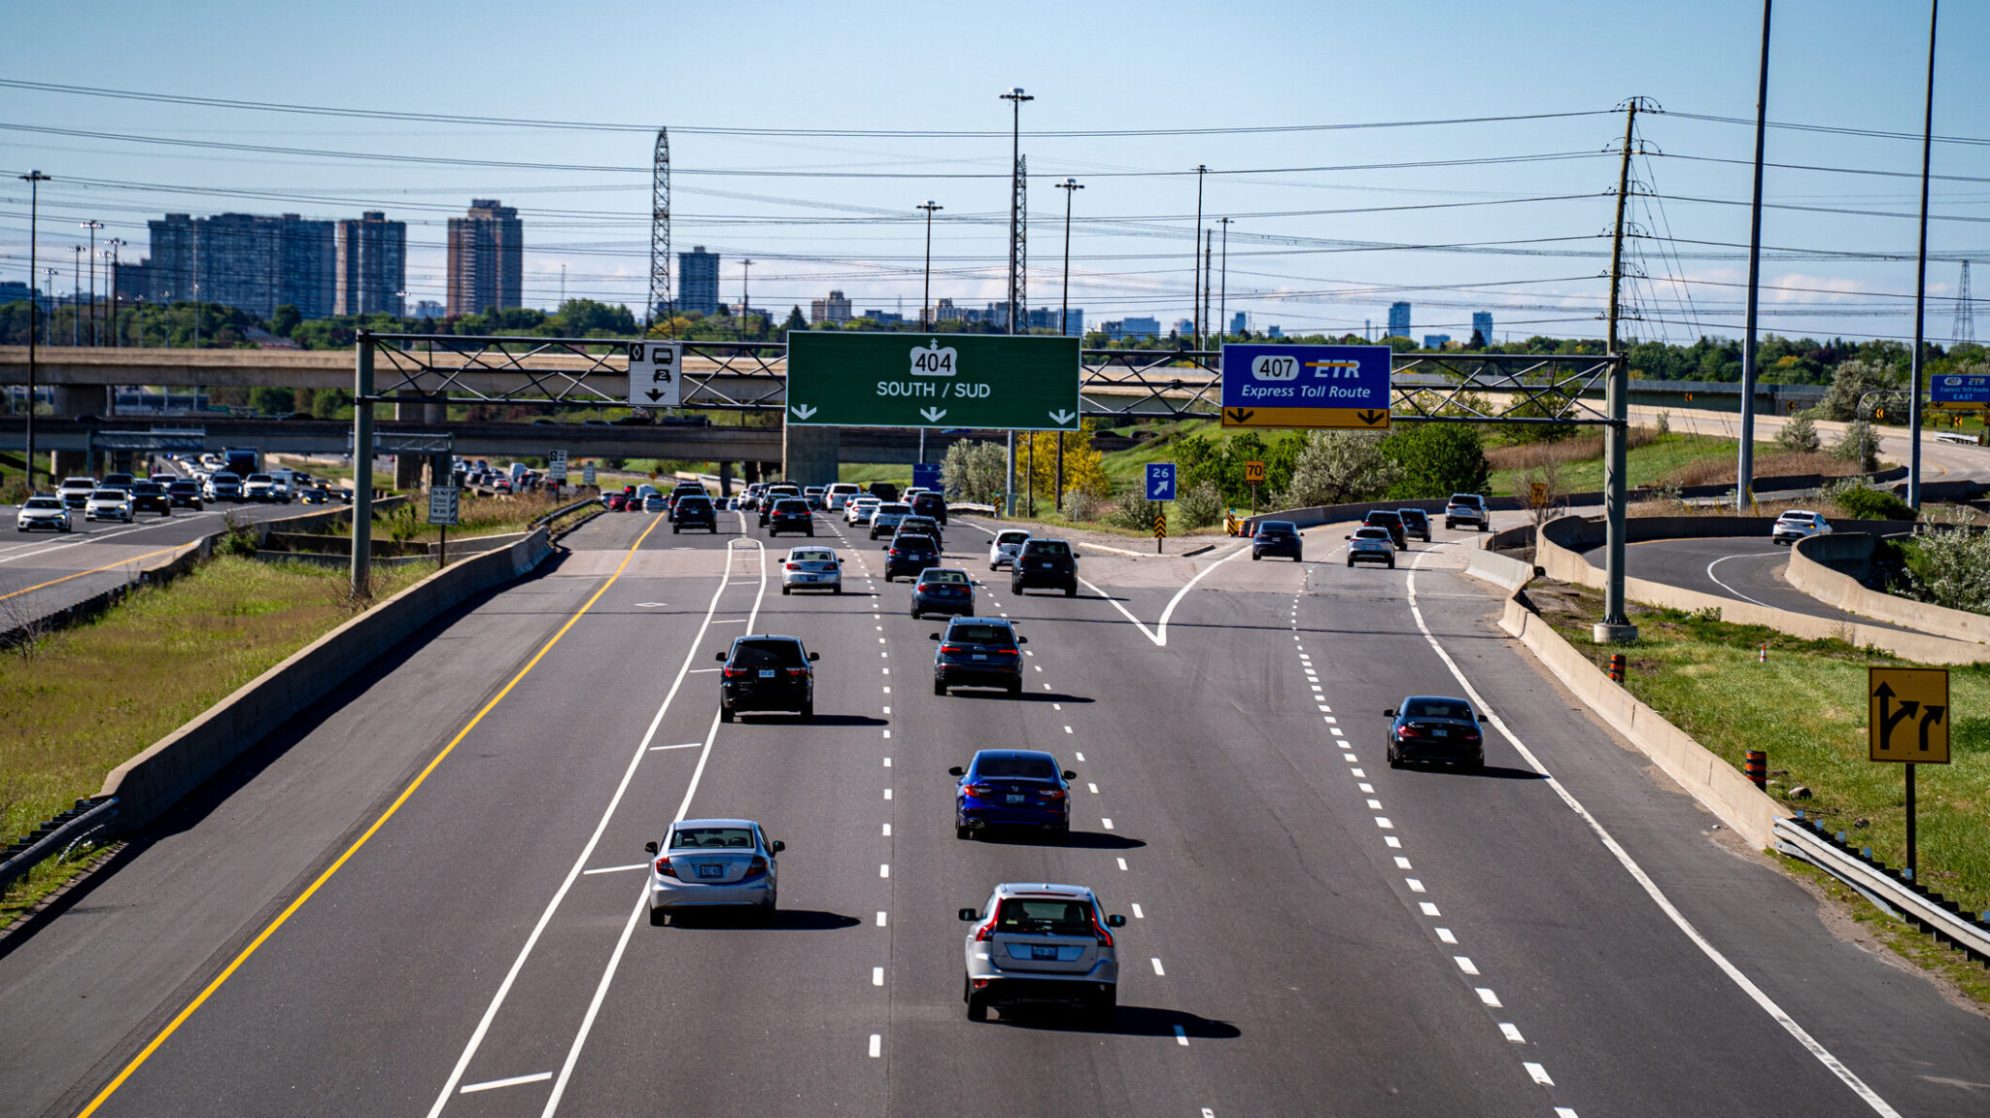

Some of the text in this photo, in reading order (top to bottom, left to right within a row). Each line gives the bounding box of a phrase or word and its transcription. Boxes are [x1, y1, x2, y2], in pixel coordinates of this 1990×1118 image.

[915, 353, 952, 372] 404
[1259, 358, 1361, 378] 407 ETR
[658, 371, 667, 379] 2
[876, 381, 991, 398] SOUTH / SUD
[1242, 384, 1371, 399] Express Toll Route
[1152, 468, 1169, 478] 26
[1248, 465, 1263, 476] 70
